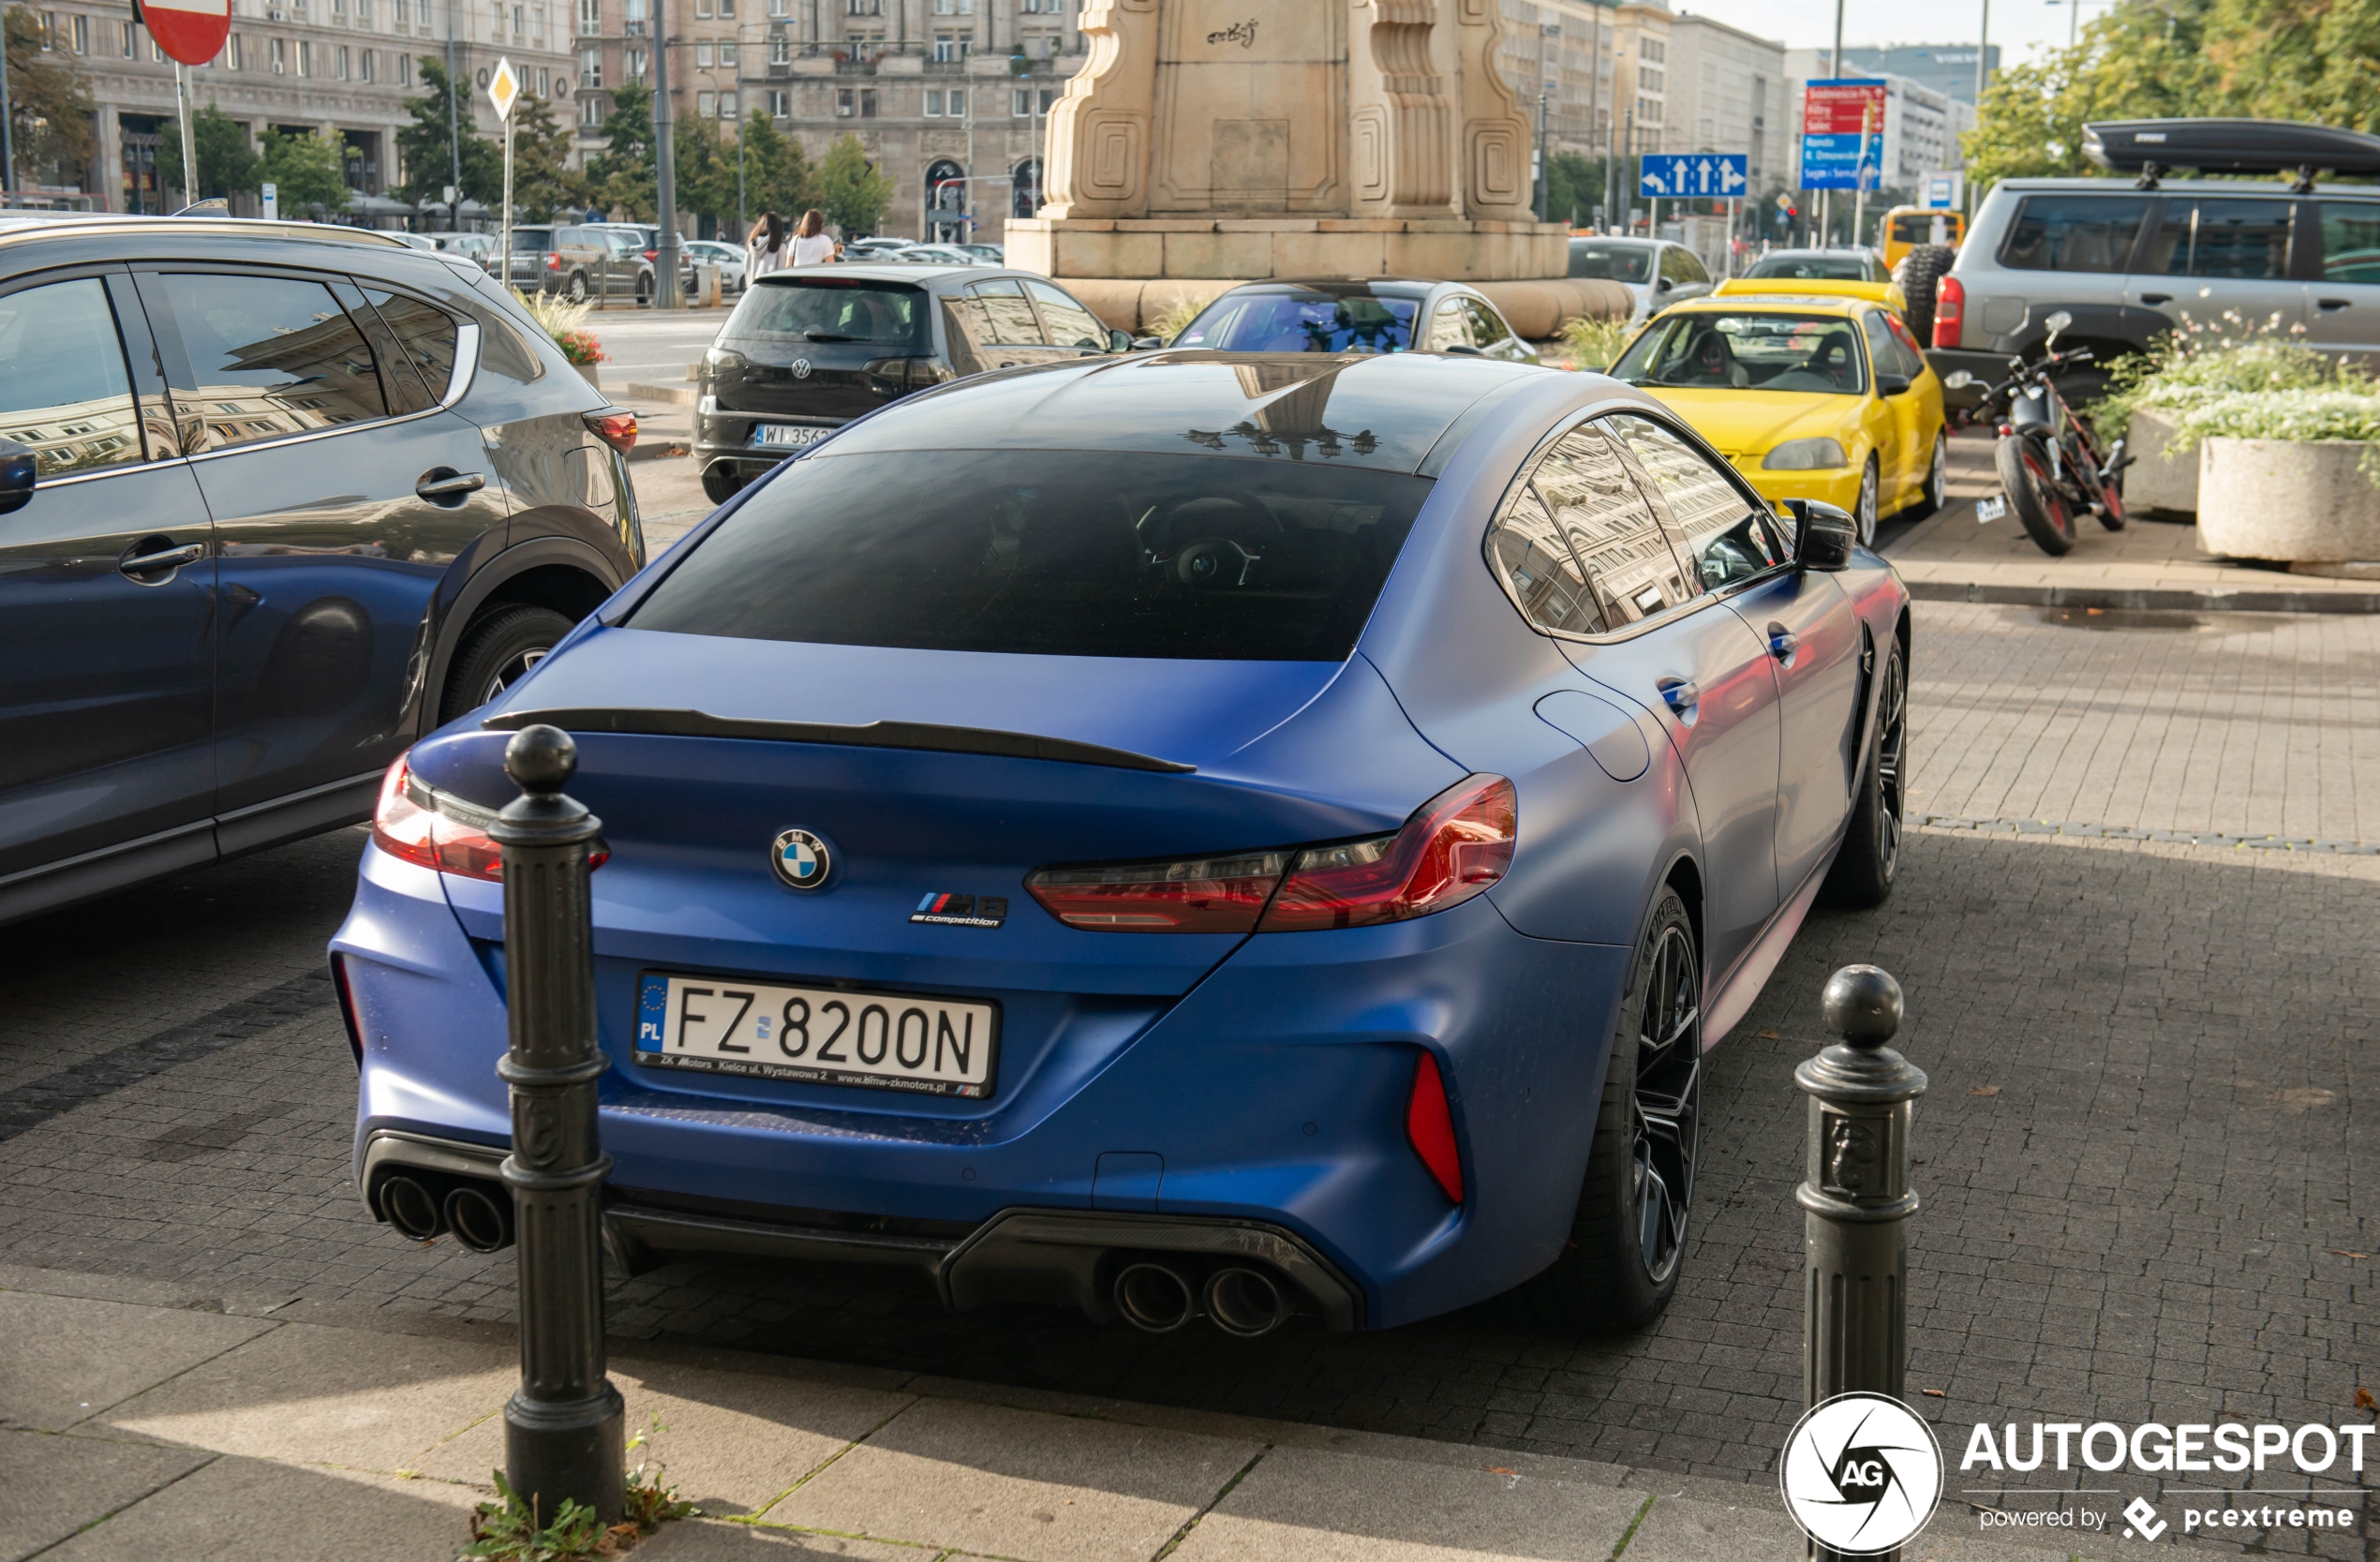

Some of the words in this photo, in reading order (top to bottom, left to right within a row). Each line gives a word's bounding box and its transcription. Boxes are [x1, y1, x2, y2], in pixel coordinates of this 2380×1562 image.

[776, 831, 823, 853] BMW
[924, 915, 1000, 928] competition
[1651, 897, 1683, 943] MICHELIN
[640, 1022, 661, 1041] PL
[677, 987, 755, 1054] FZ
[780, 996, 973, 1075] 8200N
[660, 1054, 675, 1065] ZK
[677, 1056, 712, 1069] Motors
[718, 1061, 747, 1074] Kielce
[749, 1064, 761, 1075] ul.
[763, 1065, 819, 1081] Wystawowa
[820, 1071, 827, 1080] 2
[837, 1073, 946, 1093] www.bmw-zkmotors.pl
